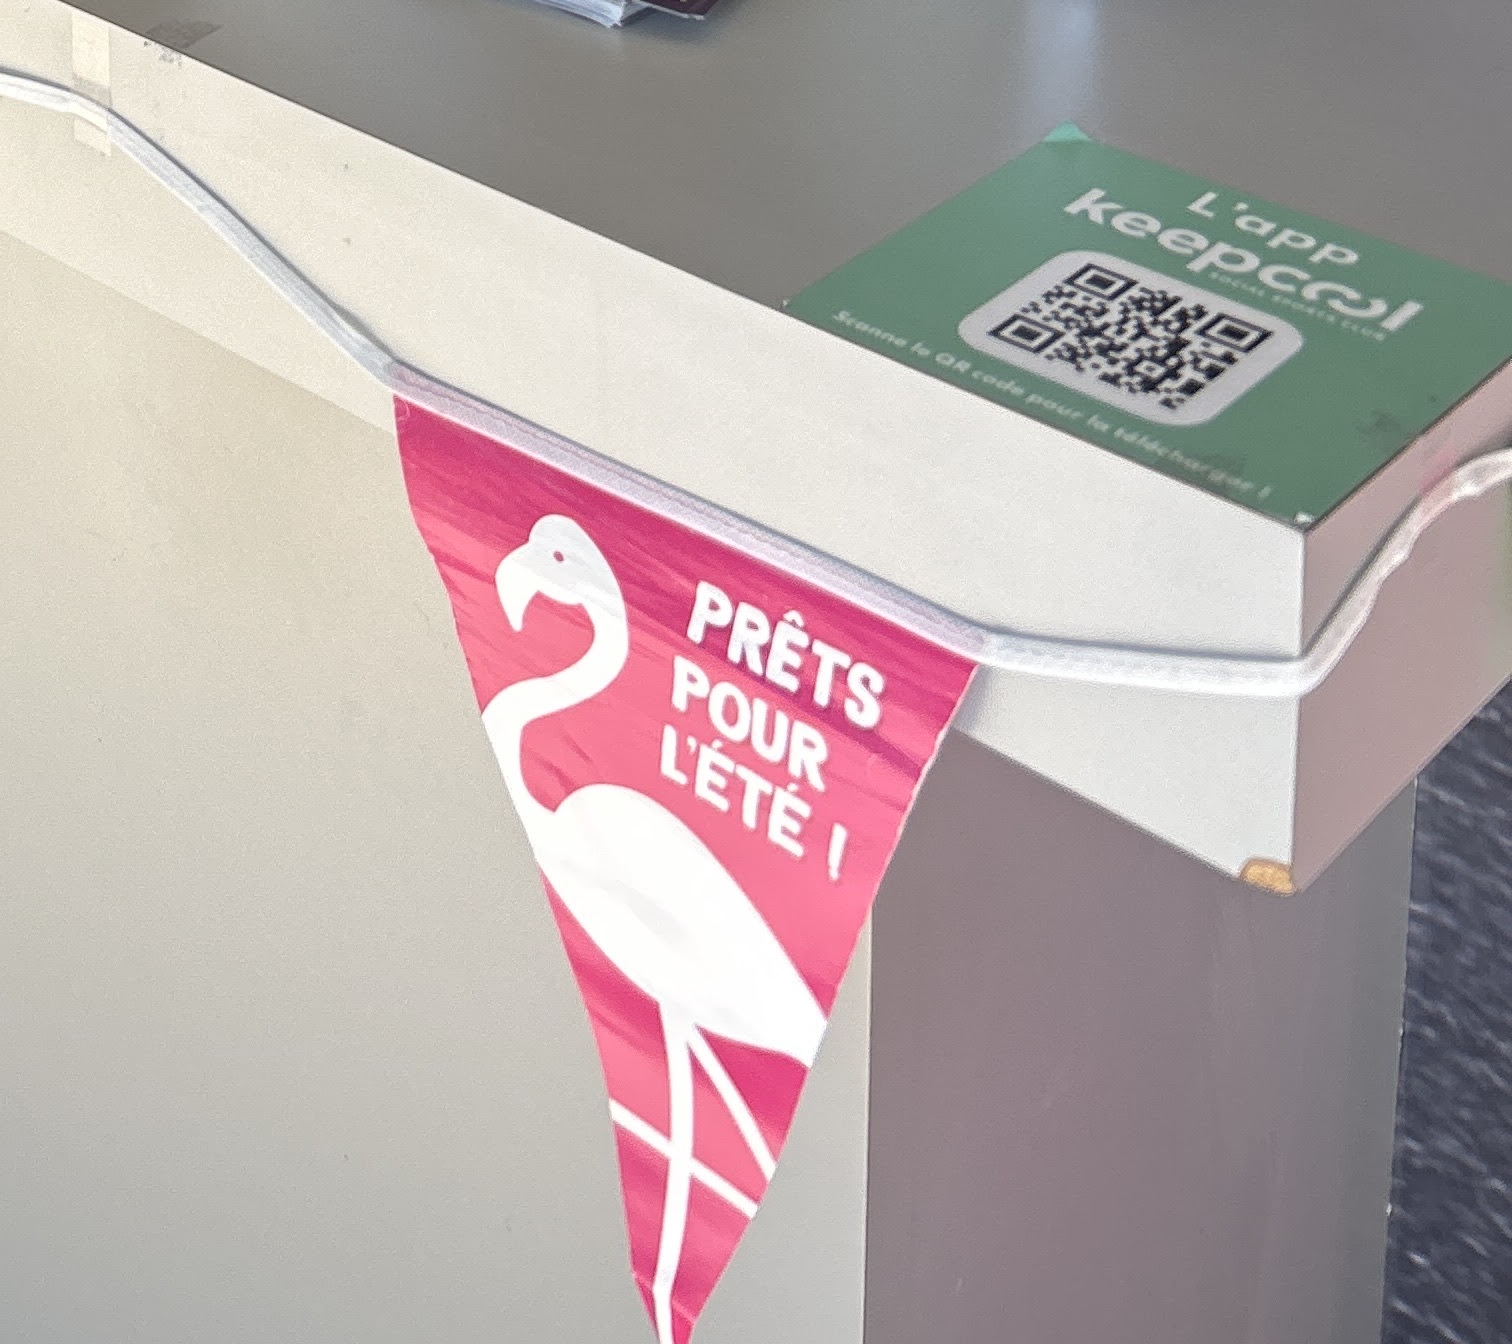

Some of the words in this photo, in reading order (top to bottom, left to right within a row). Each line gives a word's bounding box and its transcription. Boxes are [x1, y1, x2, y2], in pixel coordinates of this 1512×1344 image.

[1064, 187, 1424, 330] keepcool
[1187, 191, 1359, 266] L'app
[833, 310, 908, 348] Scanne
[935, 352, 974, 374] QR
[972, 368, 1026, 397] code
[1025, 392, 1086, 420] pour
[668, 655, 829, 793] POUR
[687, 579, 886, 732] PRÊTS
[657, 722, 812, 859] L'ÉTÉ
[826, 822, 849, 882] !
